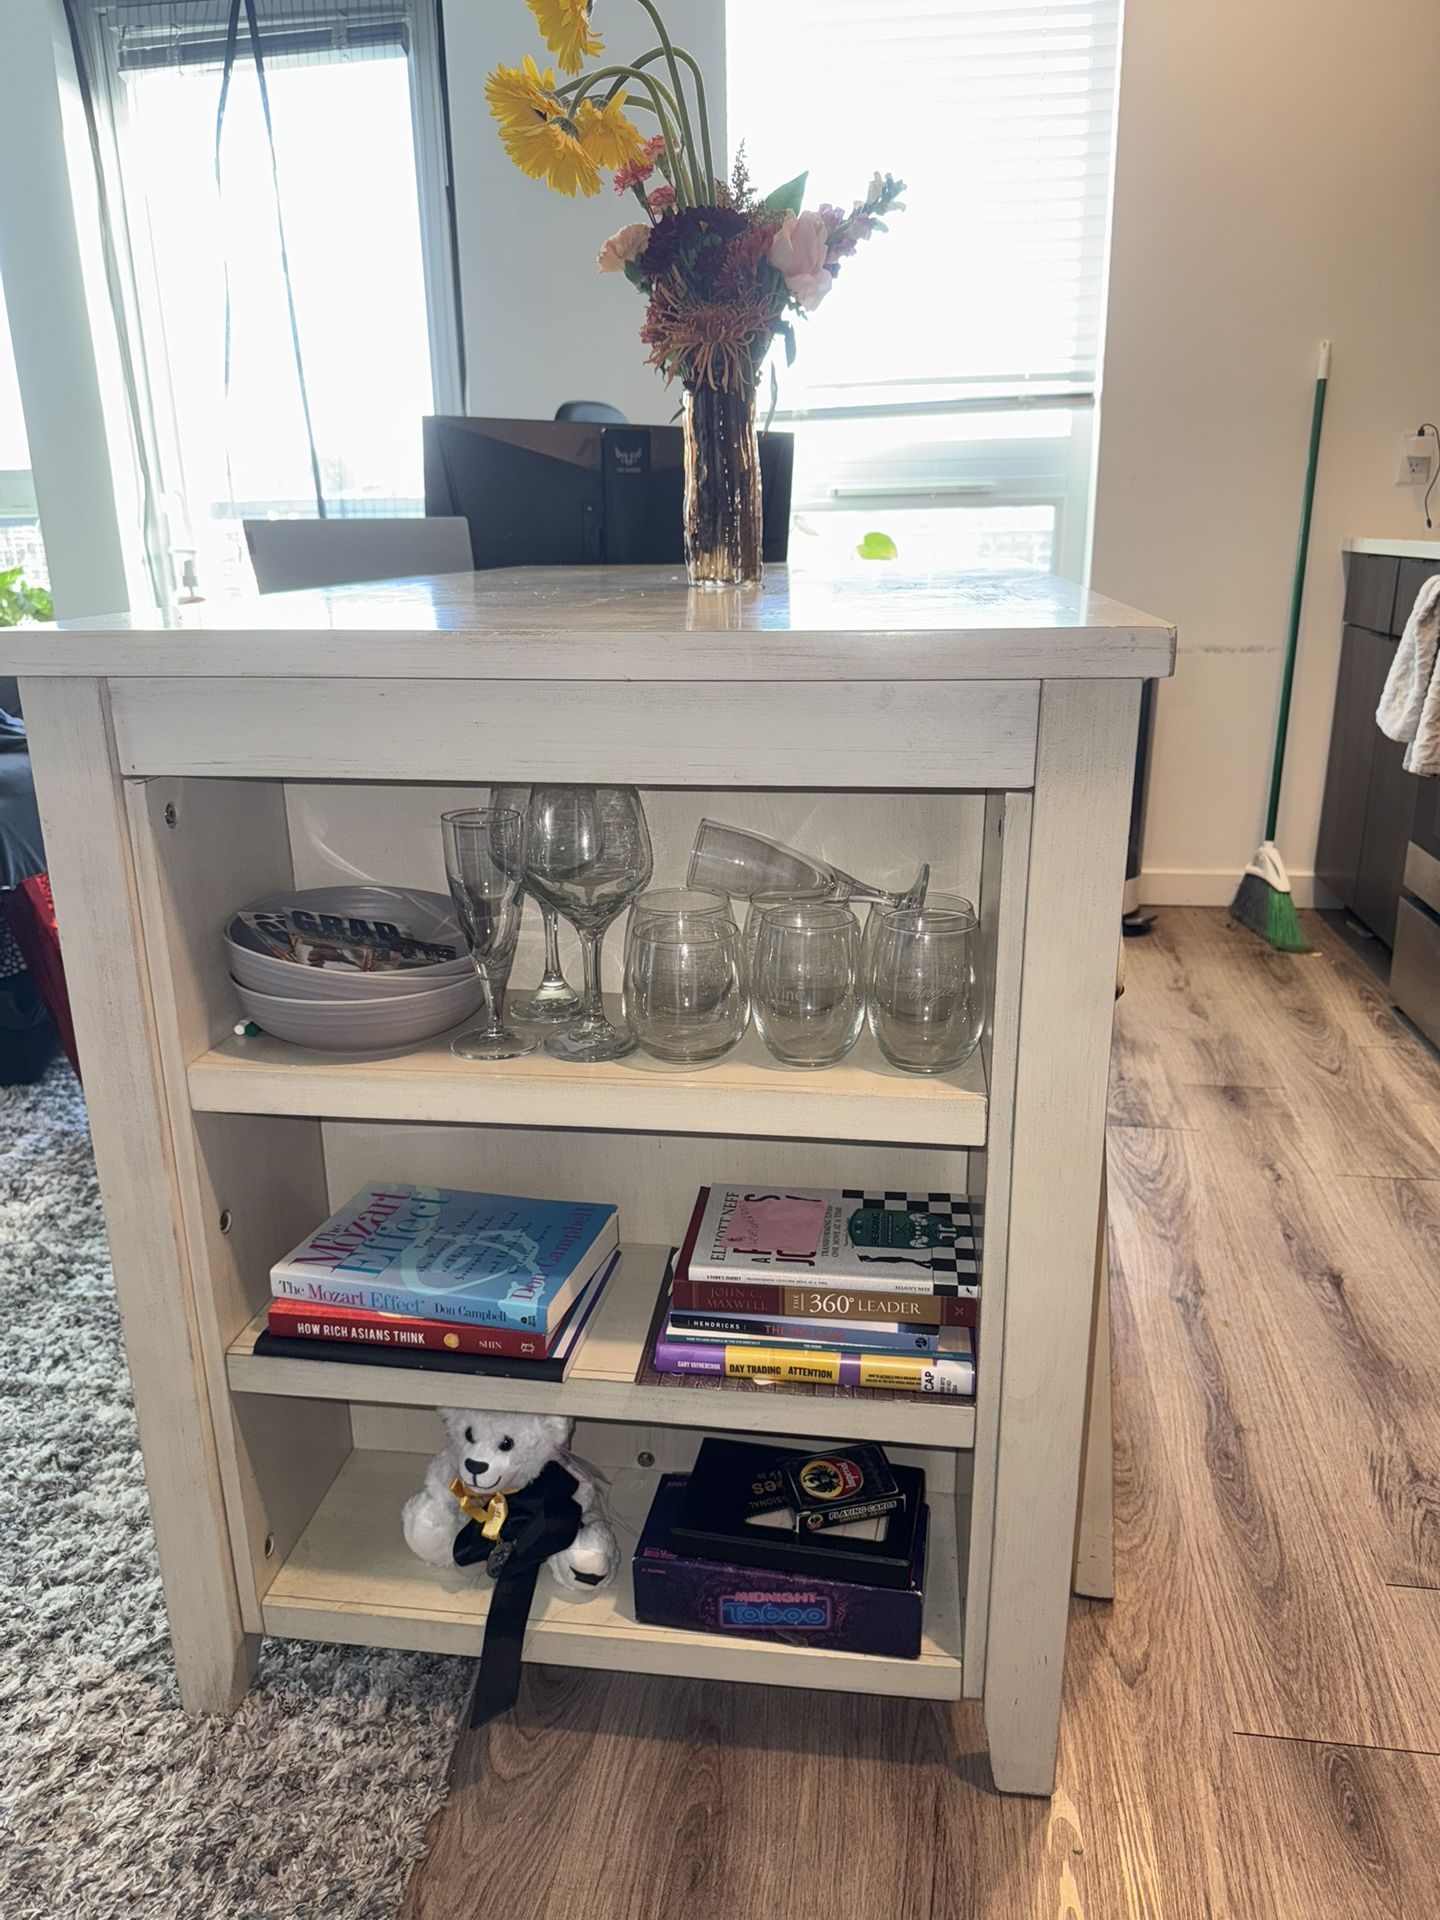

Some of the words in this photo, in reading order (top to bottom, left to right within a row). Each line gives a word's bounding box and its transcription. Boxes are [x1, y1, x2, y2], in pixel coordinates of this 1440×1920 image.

[721, 1191, 739, 1217] NEFF
[288, 1191, 411, 1274] Mozart
[312, 1224, 343, 1243] The
[335, 1192, 450, 1279] Effect
[511, 1273, 548, 1300] Don
[539, 1207, 596, 1268] Campbell
[279, 1280, 305, 1296] The
[307, 1283, 367, 1306] Mozart
[370, 1291, 421, 1314] Effect
[711, 1287, 745, 1299] JOHN
[435, 1302, 456, 1316] Don
[458, 1305, 507, 1323] Campbell
[705, 1299, 768, 1312] MAXWELL
[858, 1301, 922, 1315] LEADER
[297, 1322, 321, 1335] HOW
[323, 1325, 348, 1338] RICH
[351, 1327, 391, 1341] ASIANS
[393, 1330, 425, 1344] THINK
[693, 1321, 741, 1331] HENDRICKS
[763, 1325, 787, 1336] THE
[478, 1339, 503, 1351] SHIN
[677, 1360, 690, 1369] GARY
[729, 1364, 745, 1374] DAY
[747, 1365, 782, 1376] TRADING
[788, 1366, 833, 1380] ATTENTION
[924, 1371, 935, 1391] CAP
[828, 1504, 867, 1521] PLAYING
[867, 1500, 898, 1514] CARDS
[734, 1591, 817, 1604] MIDNIGHT
[724, 1602, 826, 1625] Taboo
